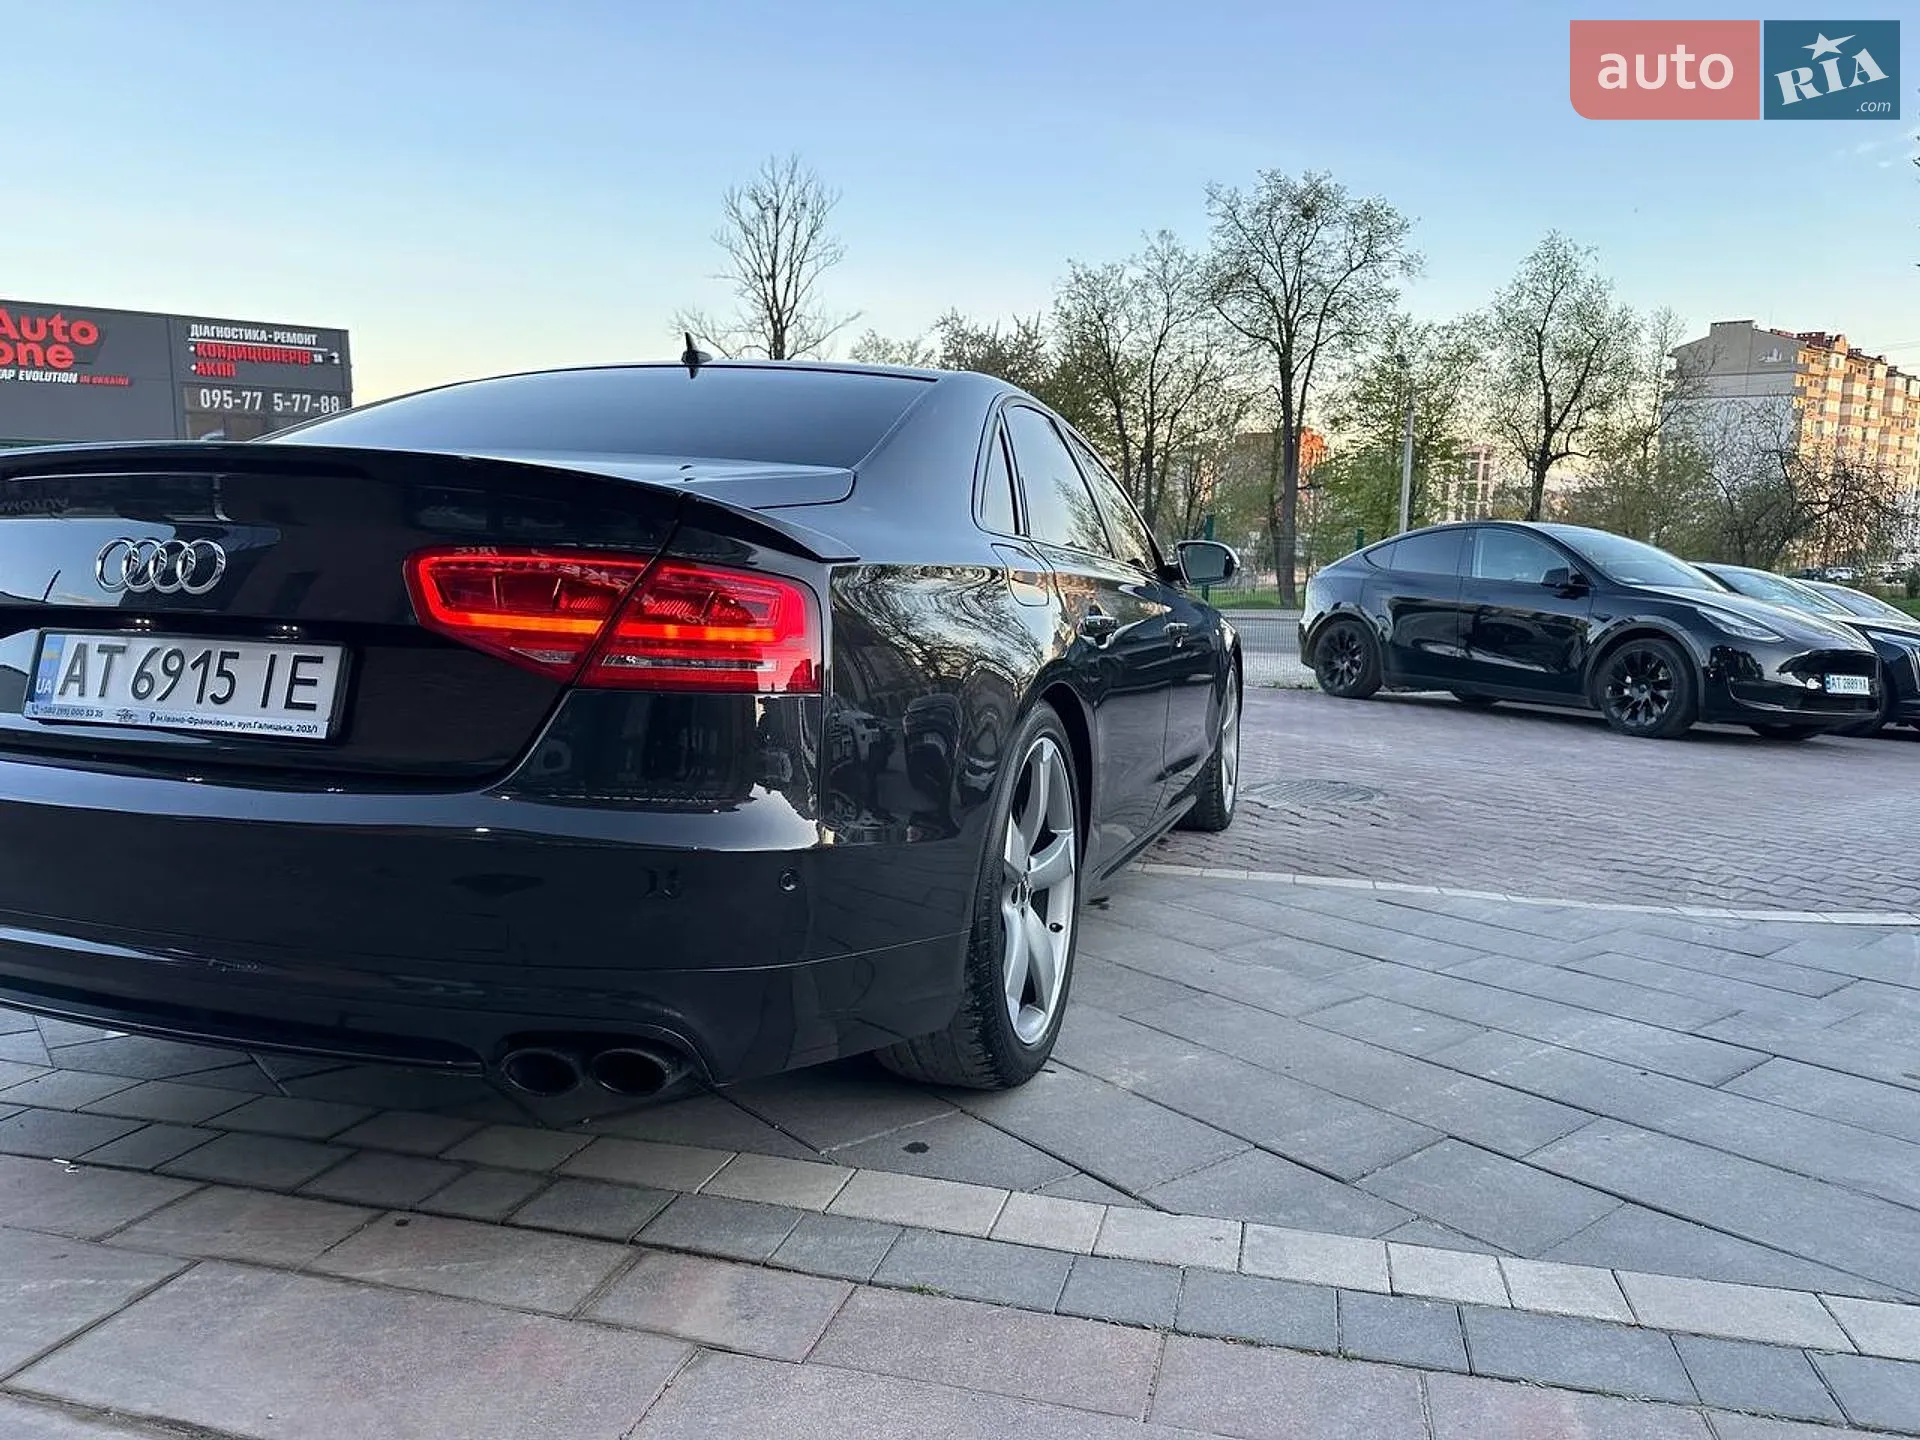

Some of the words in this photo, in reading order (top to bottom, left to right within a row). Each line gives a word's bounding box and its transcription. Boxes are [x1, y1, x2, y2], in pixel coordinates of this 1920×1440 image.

[19, 370, 79, 385] EVOLUTION
[59, 643, 127, 698] AT
[131, 646, 240, 706] 6915
[260, 654, 324, 711] IE
[36, 678, 52, 694] UA
